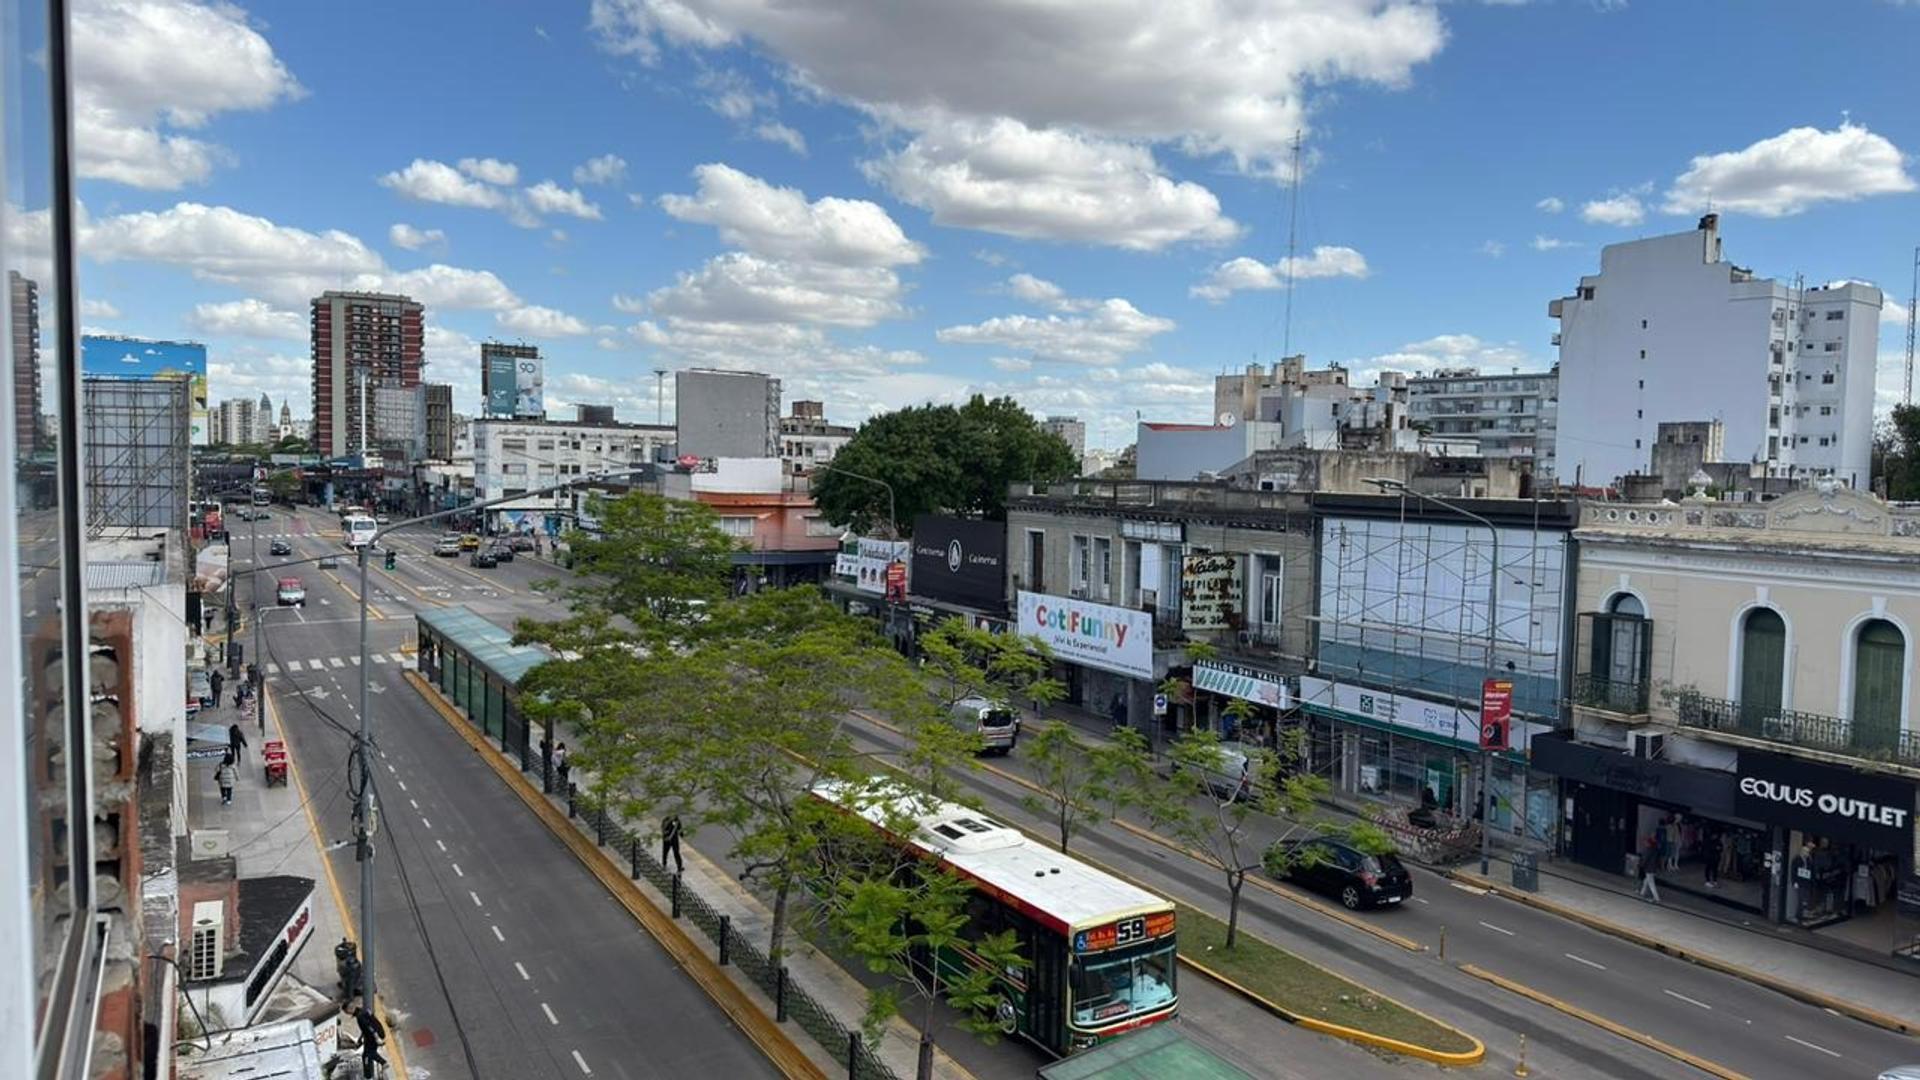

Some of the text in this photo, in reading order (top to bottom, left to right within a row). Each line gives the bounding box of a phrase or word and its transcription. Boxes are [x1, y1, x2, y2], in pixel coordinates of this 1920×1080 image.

[1036, 605, 1127, 648] CotiFunny
[1740, 777, 1907, 828] EQUUS OUTLET
[1118, 920, 1144, 942] 59
